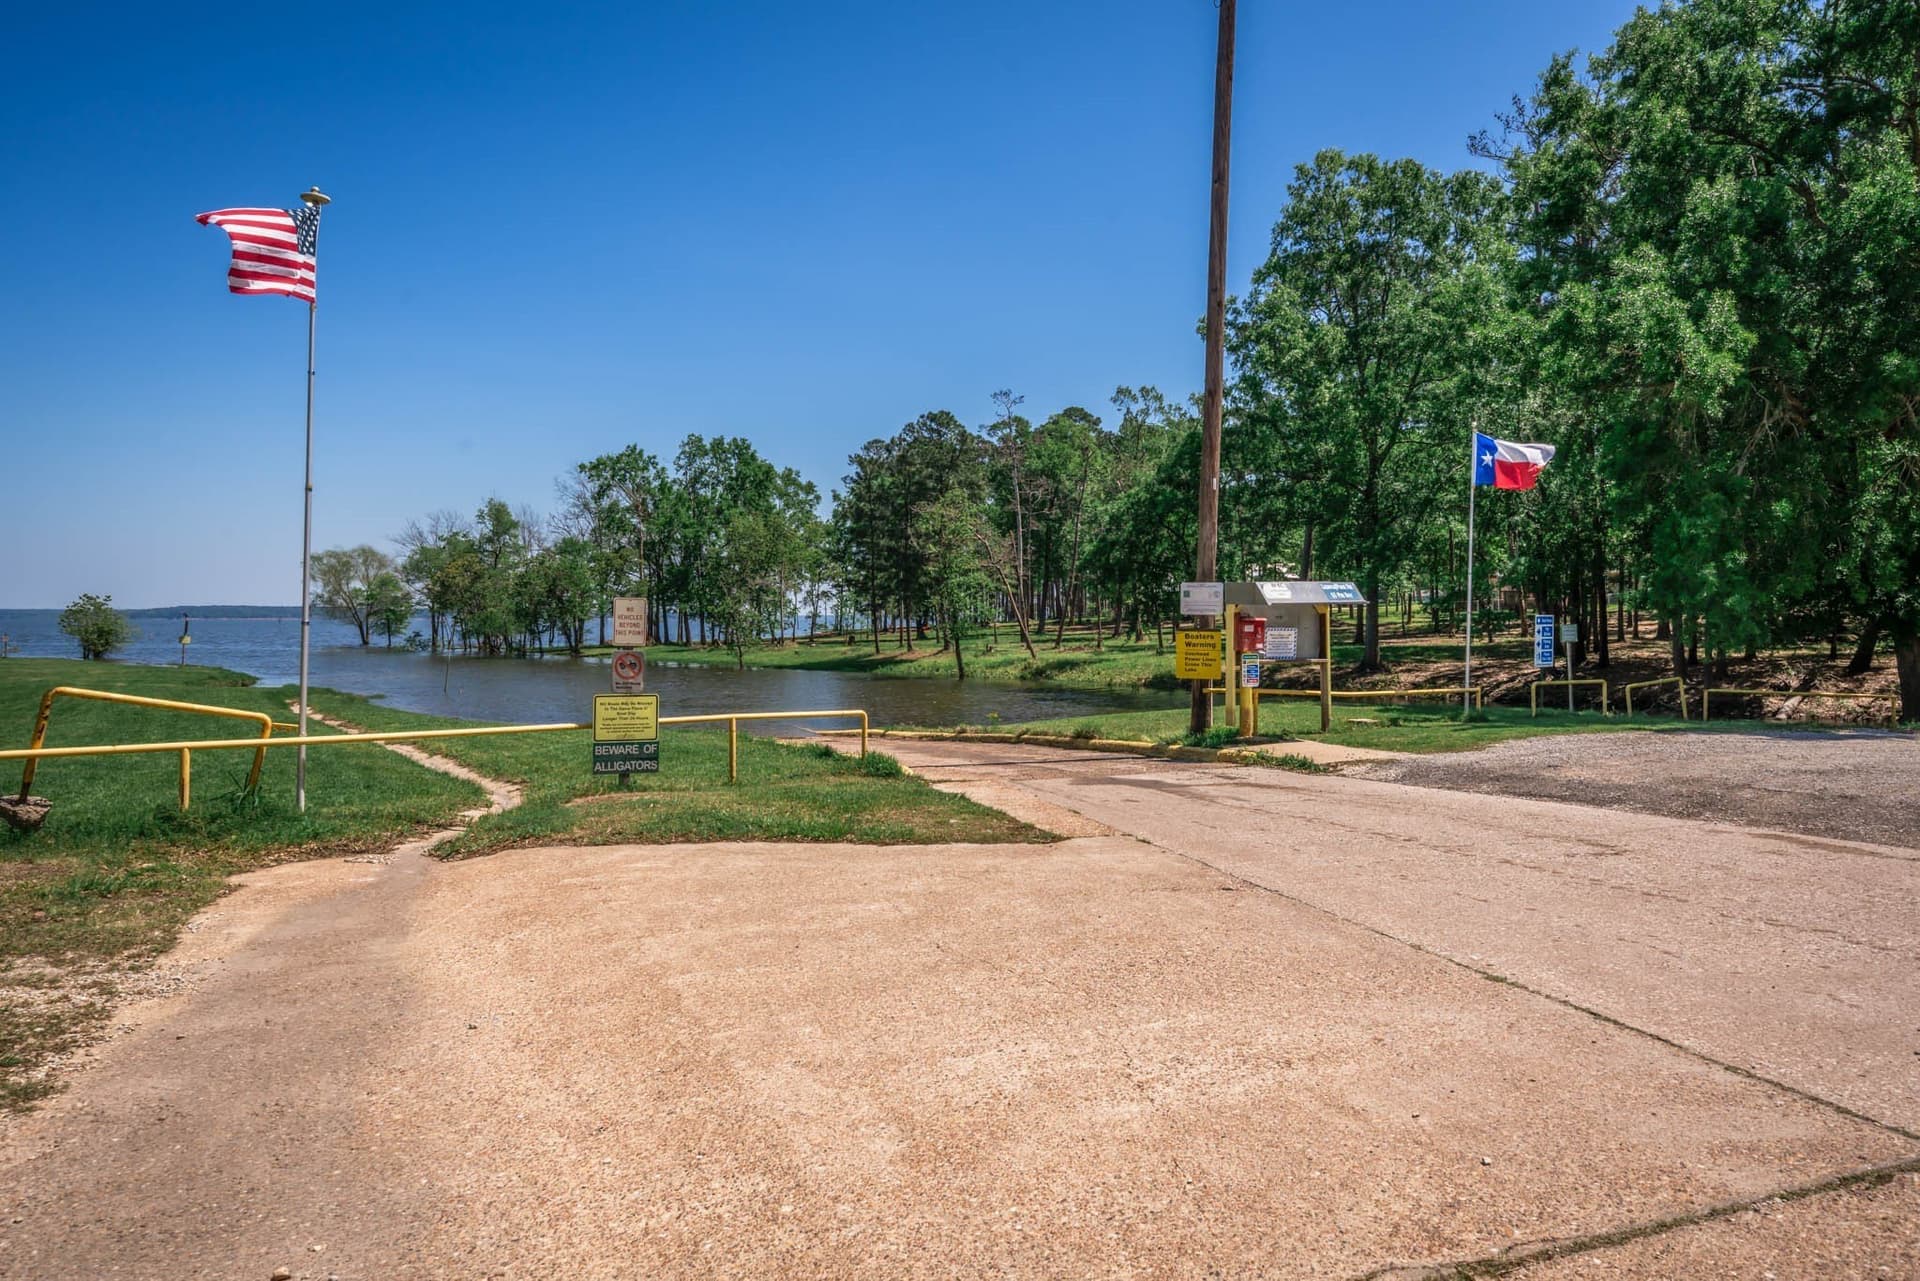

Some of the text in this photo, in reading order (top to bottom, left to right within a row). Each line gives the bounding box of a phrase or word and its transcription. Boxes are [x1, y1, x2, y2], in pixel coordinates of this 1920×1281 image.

[1184, 641, 1217, 649] Warning
[594, 744, 658, 755] BEWARE OF
[594, 760, 658, 772] ALLIGATORS
